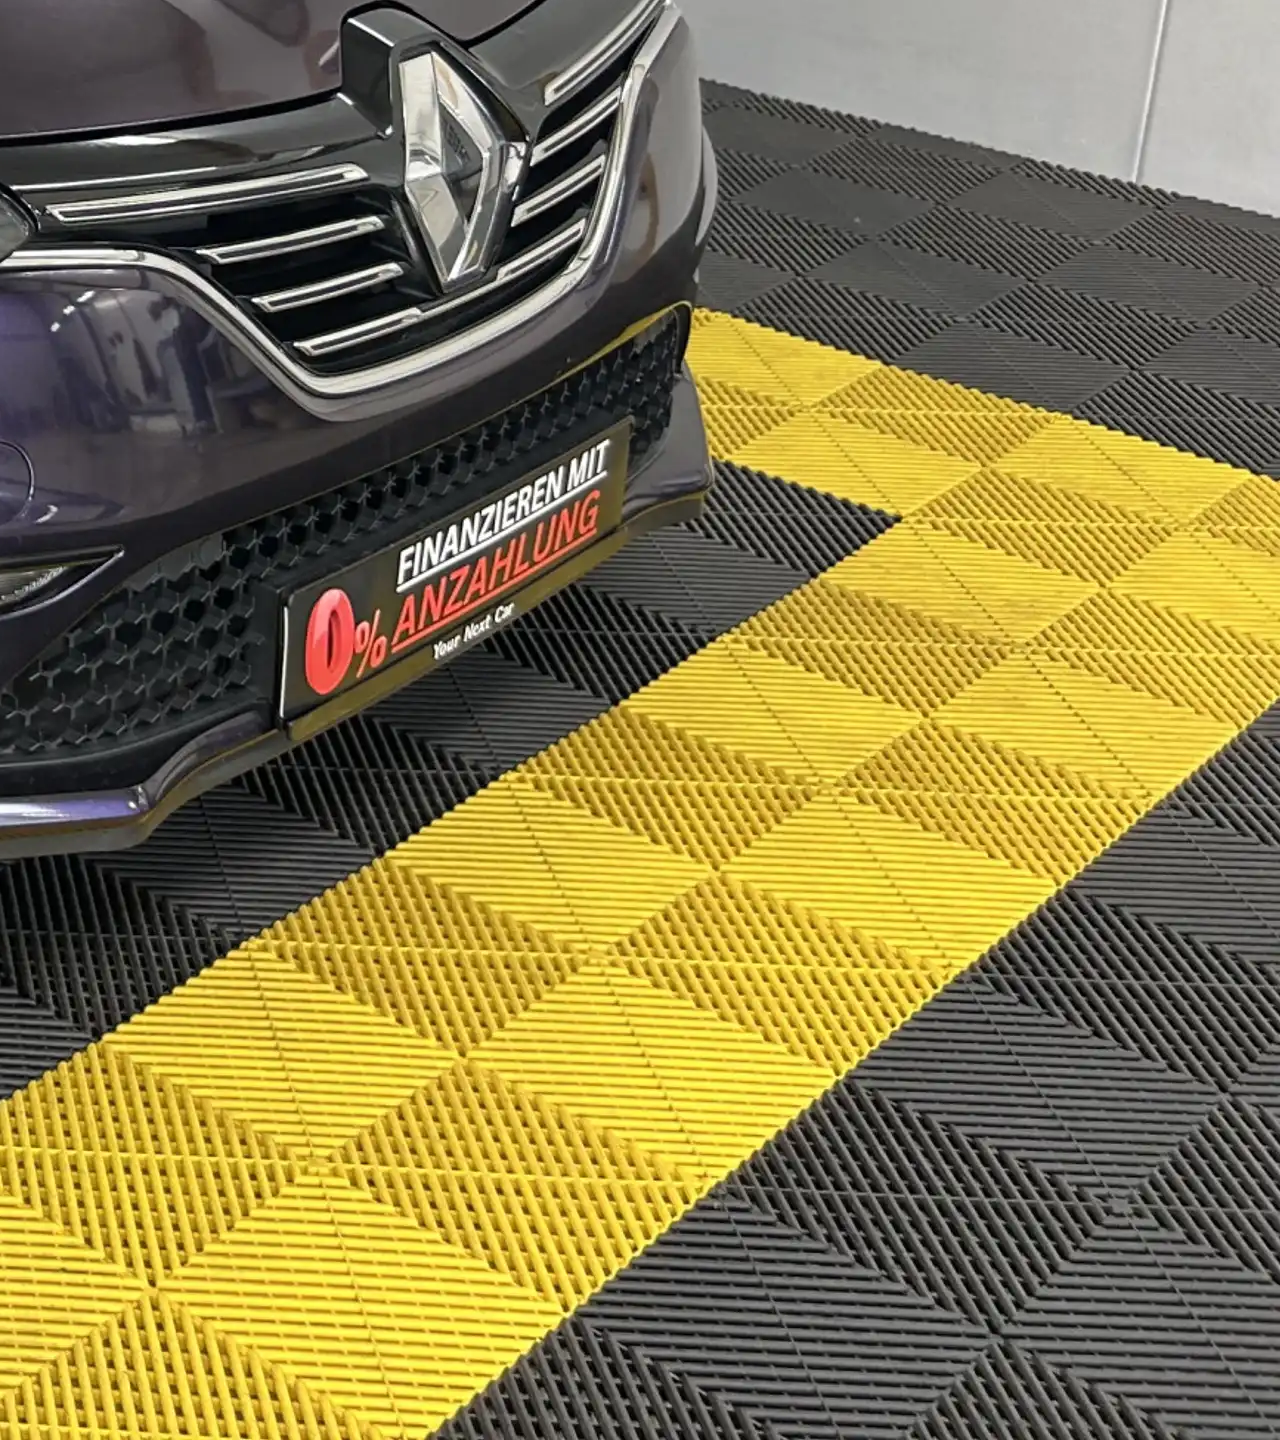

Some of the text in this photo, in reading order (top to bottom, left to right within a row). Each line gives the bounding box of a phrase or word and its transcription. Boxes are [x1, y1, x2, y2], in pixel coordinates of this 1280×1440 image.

[390, 489, 601, 647] ANZAHLUNG
[397, 438, 611, 585] FINANZIEREN MIT
[433, 602, 516, 660] Your Next Car
